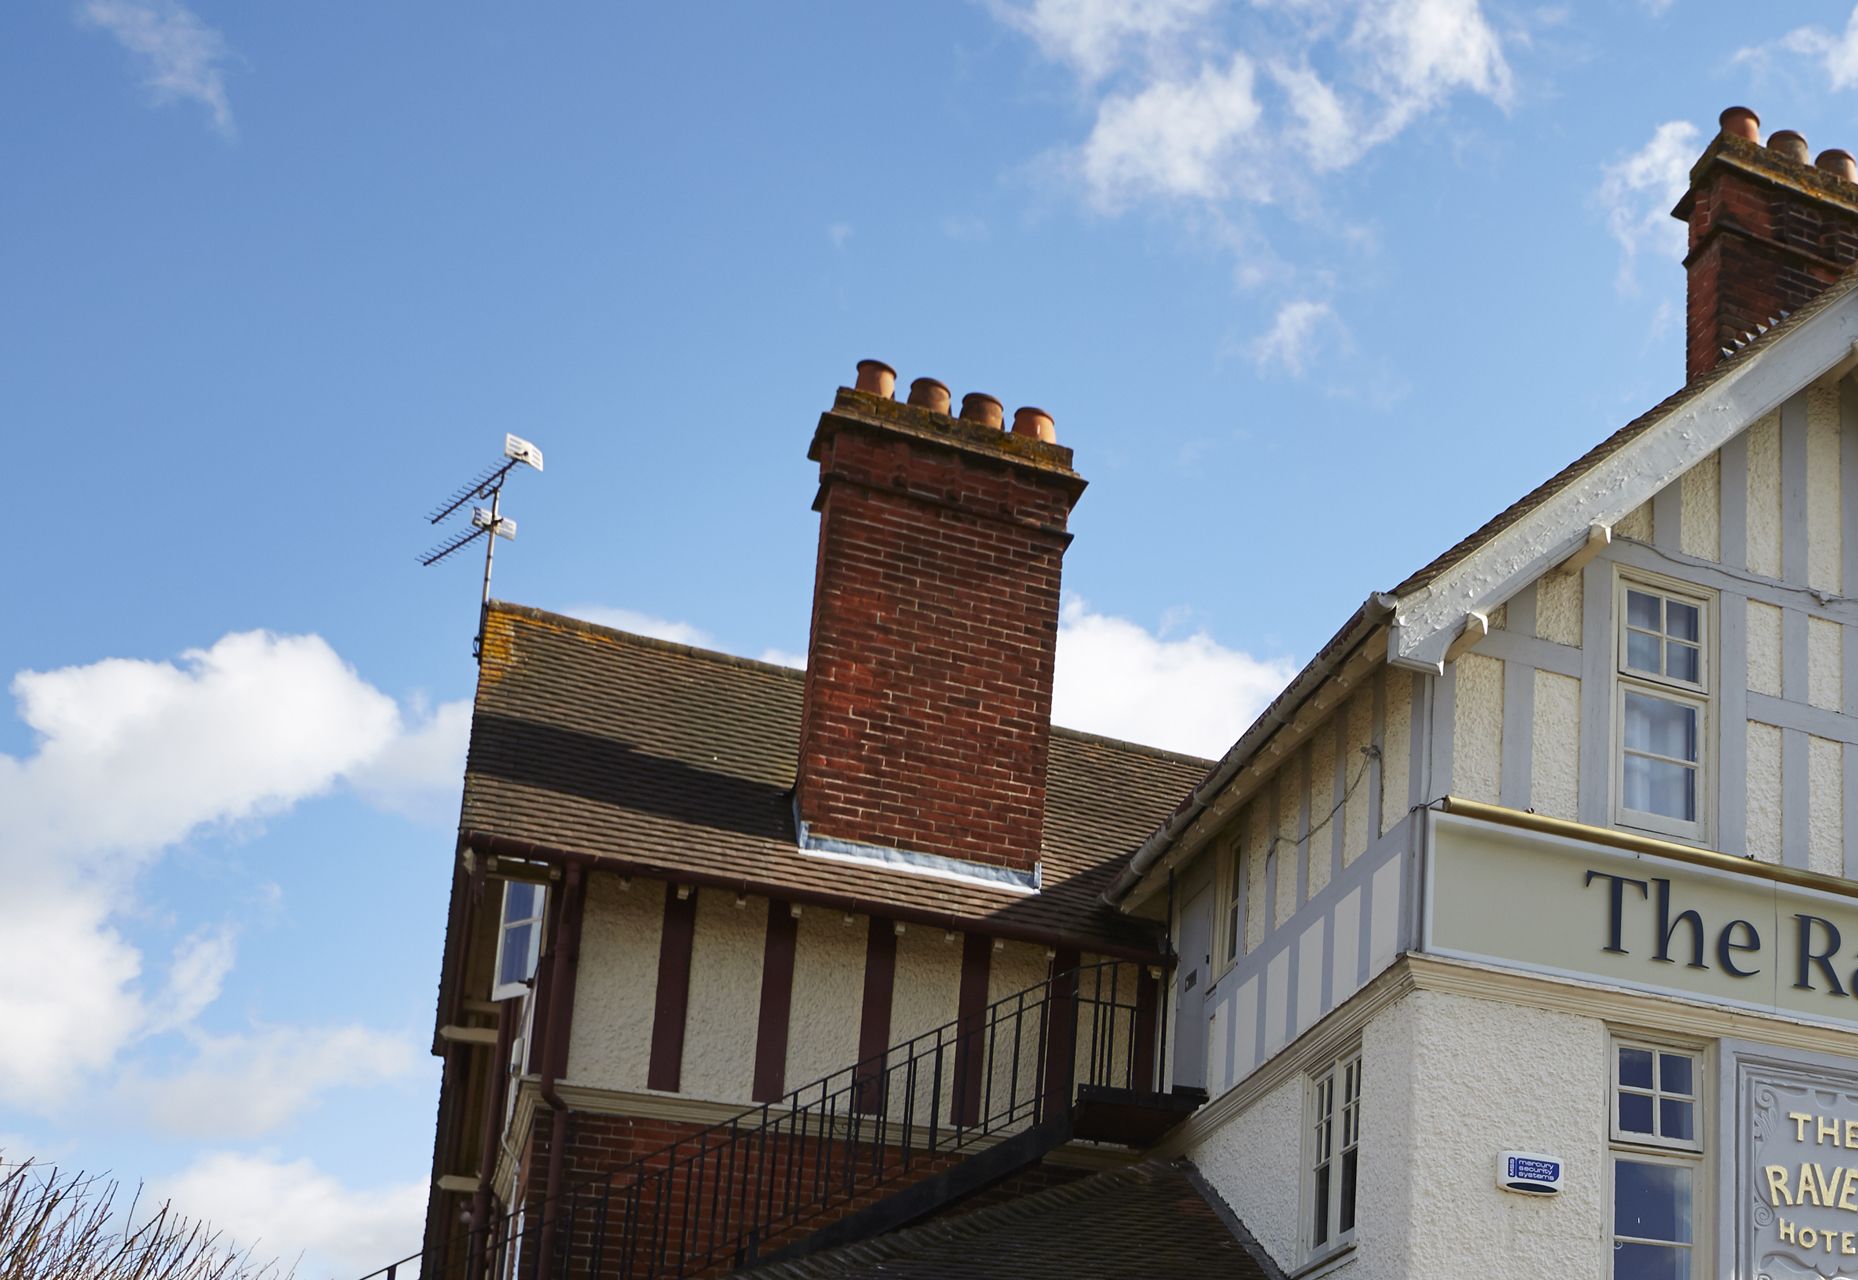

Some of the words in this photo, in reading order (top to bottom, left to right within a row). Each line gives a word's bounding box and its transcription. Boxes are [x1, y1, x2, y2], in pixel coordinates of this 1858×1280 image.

[1585, 869, 1761, 977] The
[1518, 1160, 1554, 1170] mercury
[1518, 1165, 1553, 1175] security
[1518, 1171, 1555, 1181] systems
